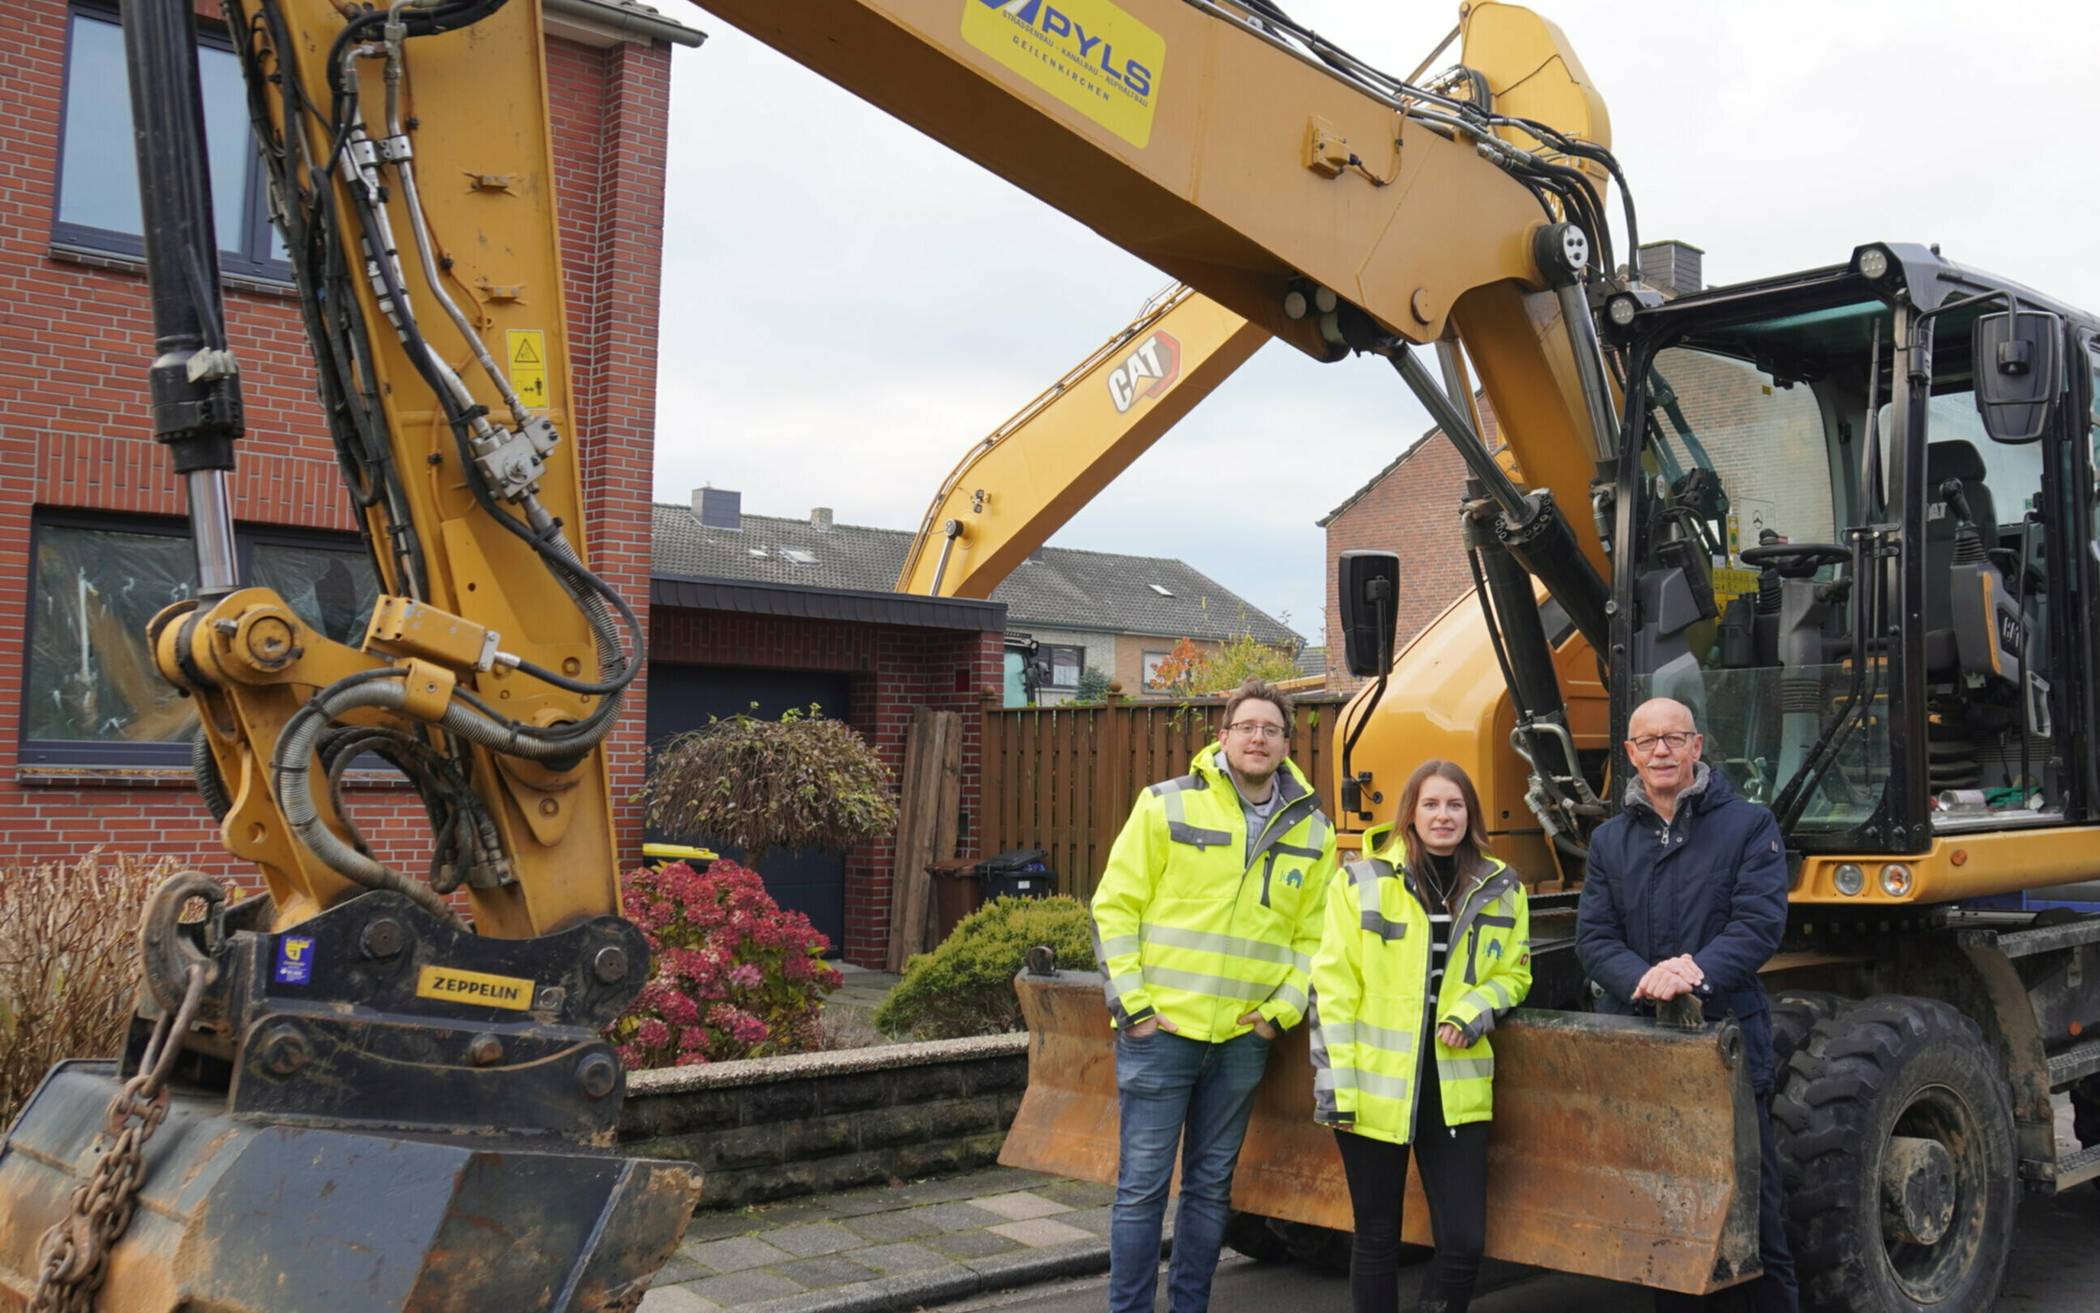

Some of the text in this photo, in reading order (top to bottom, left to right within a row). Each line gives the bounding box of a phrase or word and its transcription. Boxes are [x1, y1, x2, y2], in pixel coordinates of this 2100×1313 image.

[1002, 9, 1149, 108] STRASSENBAU KANALBAU ASPHALTBAU
[1012, 35, 1110, 101] GEILENKIRCHEN
[1042, 5, 1152, 97] PYLS
[1108, 336, 1164, 412] CAT
[1927, 502, 1948, 522] AT
[432, 976, 518, 1001] ZEPPELIN
